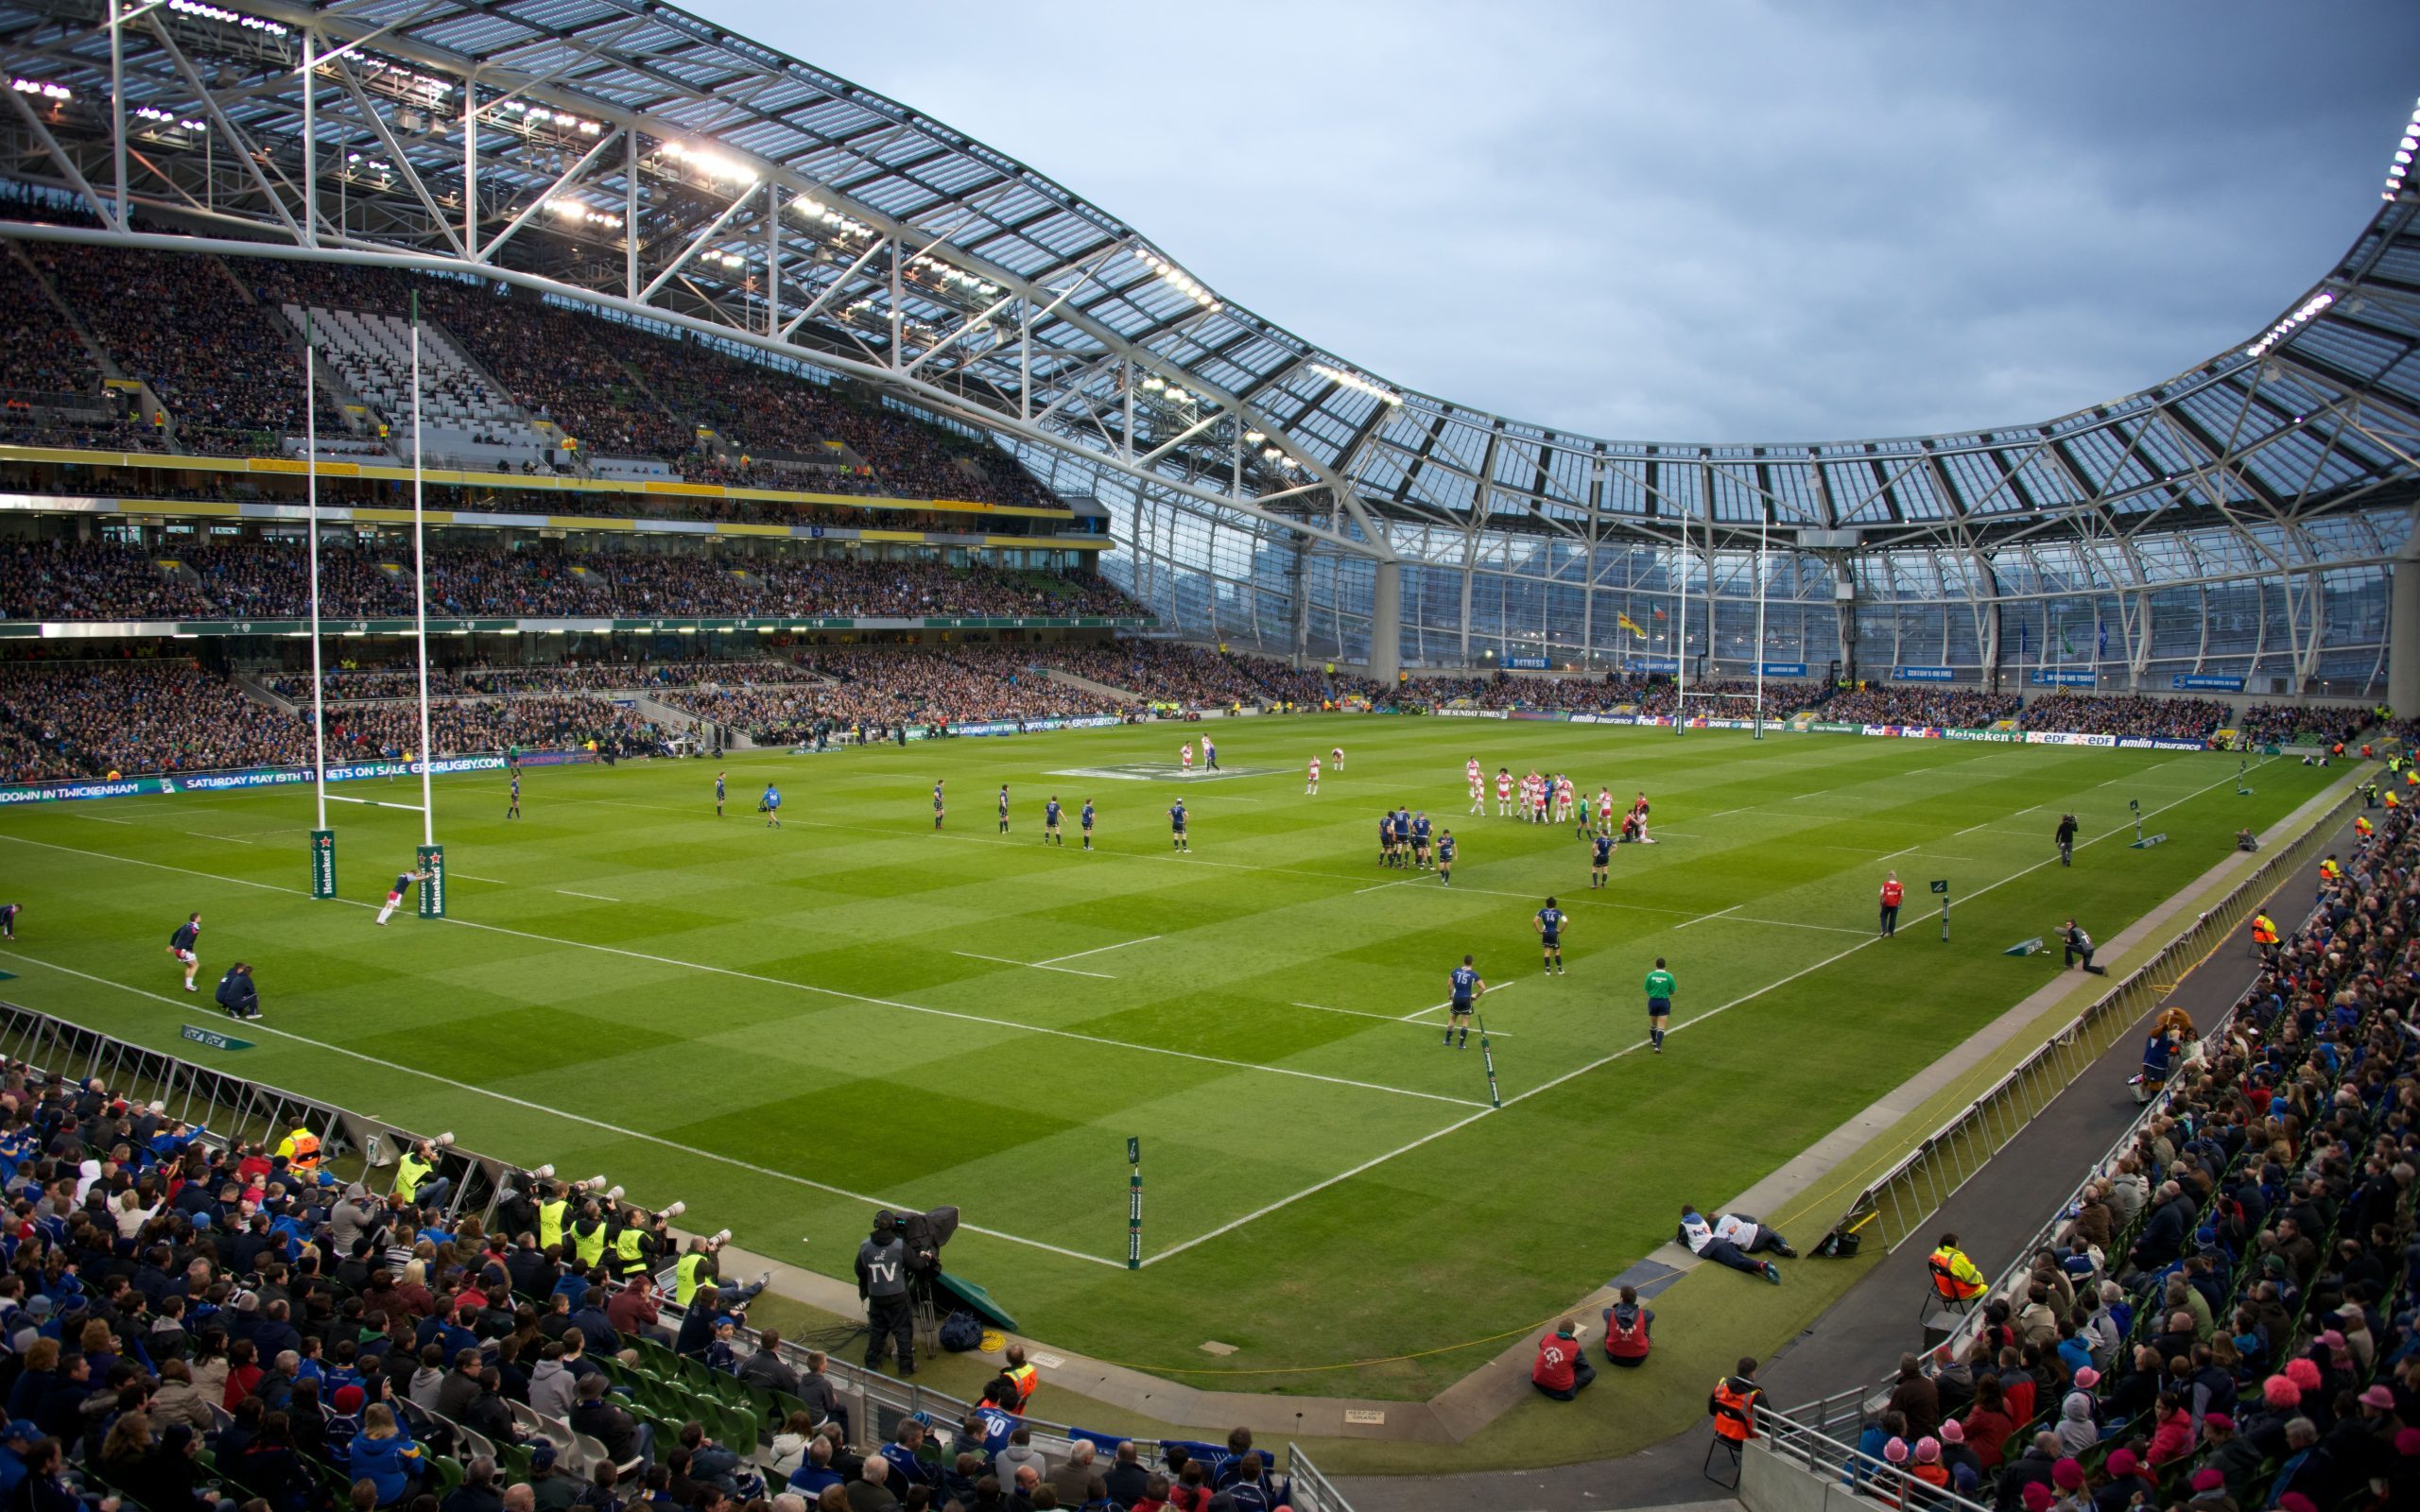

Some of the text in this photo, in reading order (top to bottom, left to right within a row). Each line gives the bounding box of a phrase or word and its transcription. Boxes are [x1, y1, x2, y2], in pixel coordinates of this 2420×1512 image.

[1597, 716, 1633, 725] Insurance
[1637, 715, 1670, 726] FedEx
[959, 724, 990, 734] SATURDAY
[1862, 725, 1899, 736] FedEx
[1902, 727, 1940, 738] FedEx
[1945, 730, 2010, 742] Heineken
[2153, 741, 2201, 750] Insurance
[43, 790, 56, 799] IN
[58, 783, 138, 798] TWICKENHAM
[187, 776, 247, 788] SATURDAY
[250, 775, 274, 783] MAY
[276, 773, 301, 782] 19TH
[355, 766, 373, 777] ON
[378, 764, 406, 776] SALE
[320, 850, 332, 894] Heineken
[433, 866, 441, 914] Heineken
[1458, 973, 1467, 985] 15
[574, 1234, 595, 1244] PHOTO
[868, 1262, 897, 1283] TV
[985, 1415, 1006, 1436] 10
